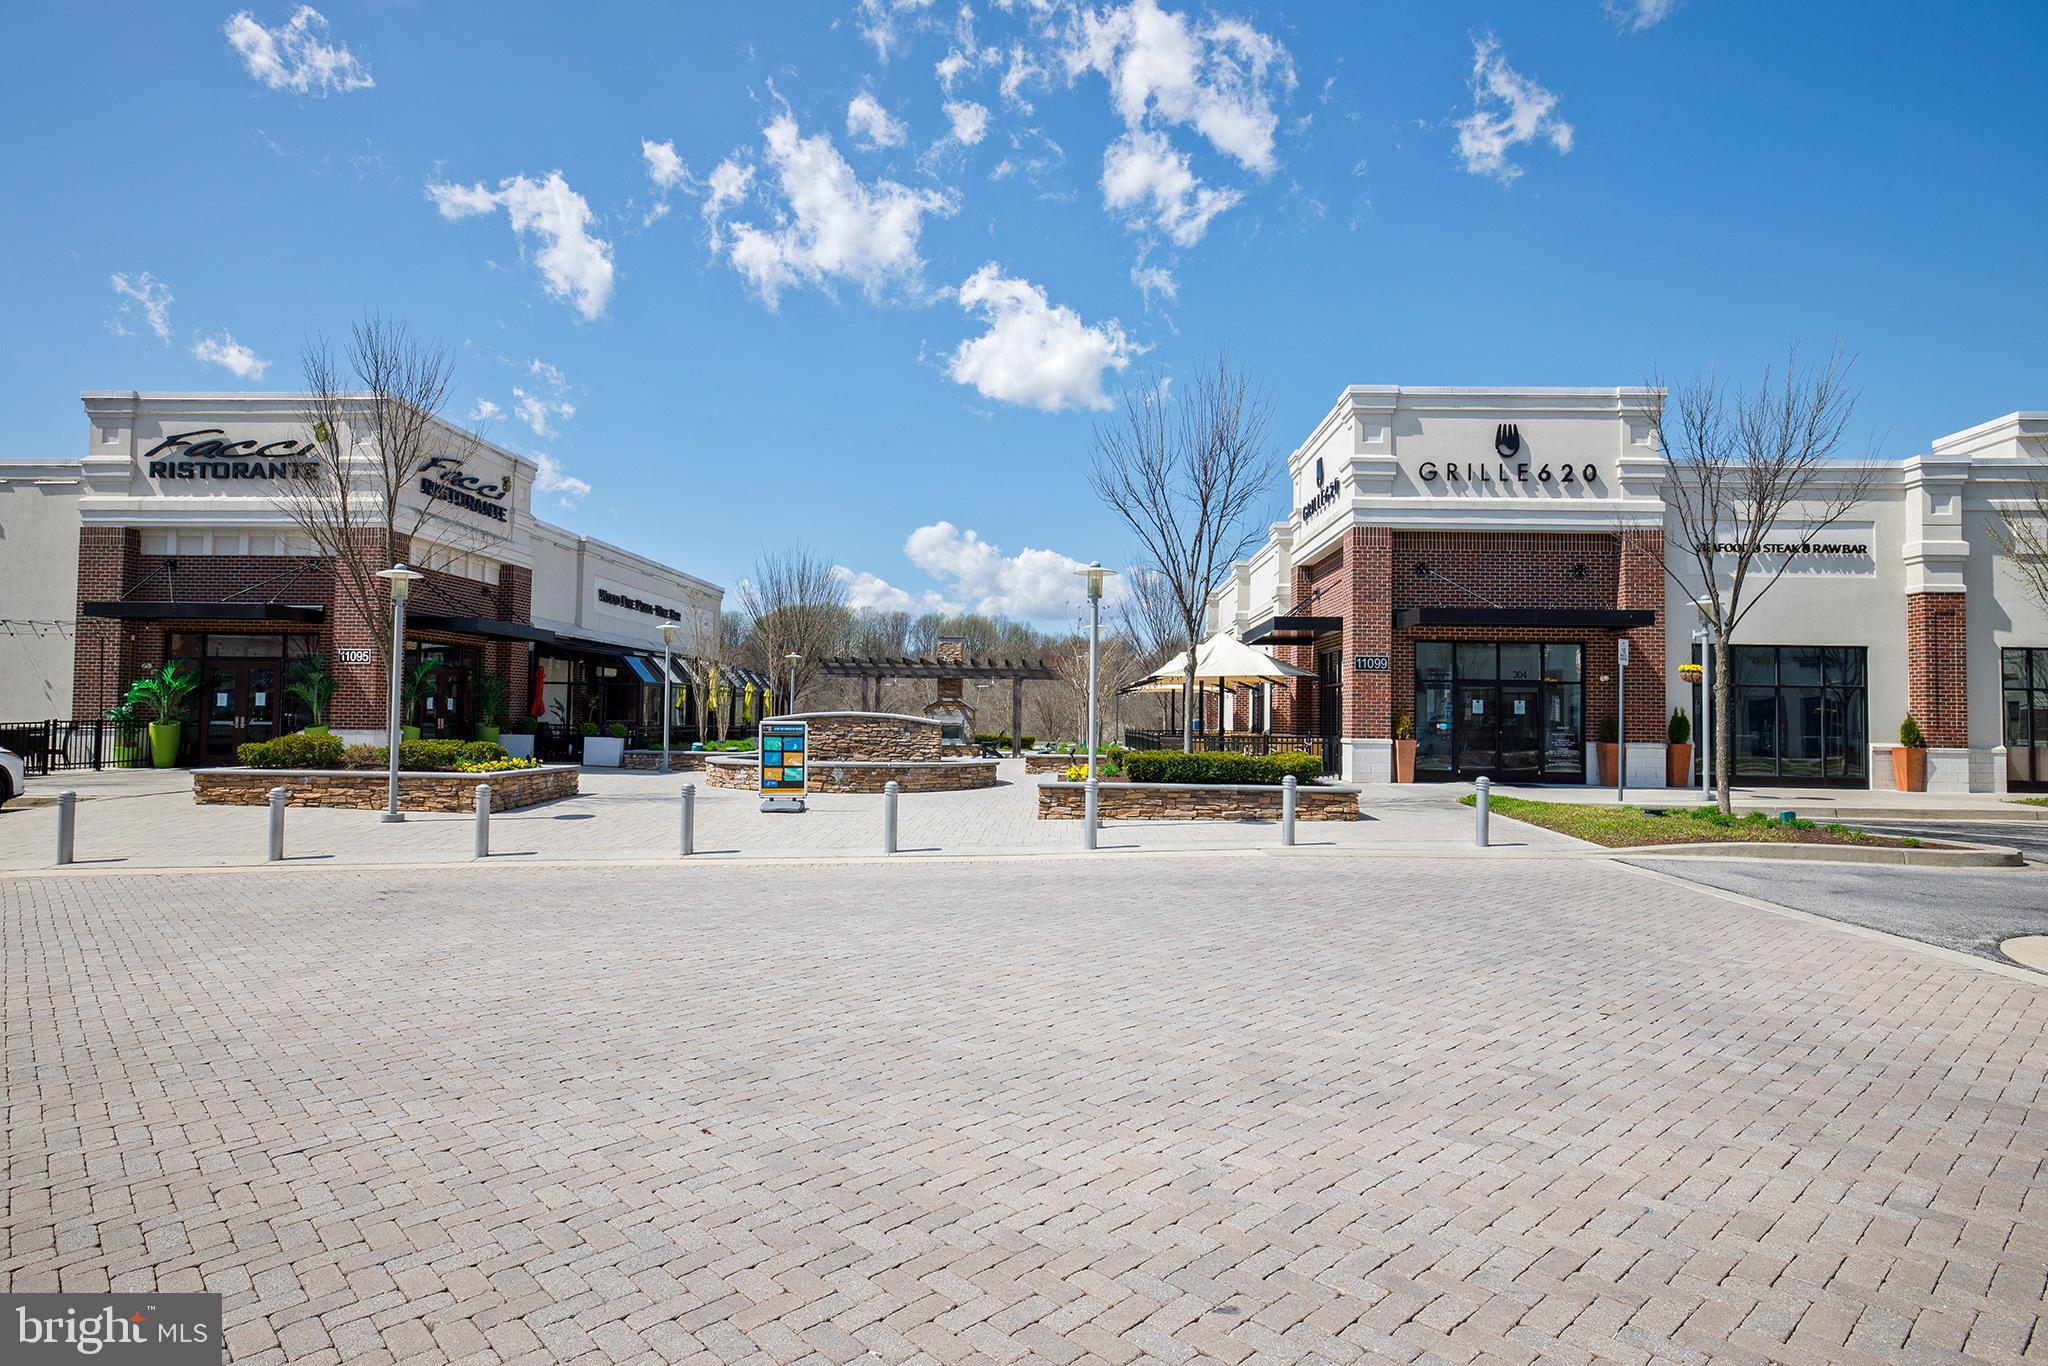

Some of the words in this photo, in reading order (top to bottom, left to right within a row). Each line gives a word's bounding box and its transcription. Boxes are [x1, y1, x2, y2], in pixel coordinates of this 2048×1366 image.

[144, 429, 316, 459] Facci
[1763, 543, 1801, 553] STEAK
[340, 650, 369, 662] 11095
[1356, 657, 1388, 669] 11099
[1512, 670, 1528, 679] 304
